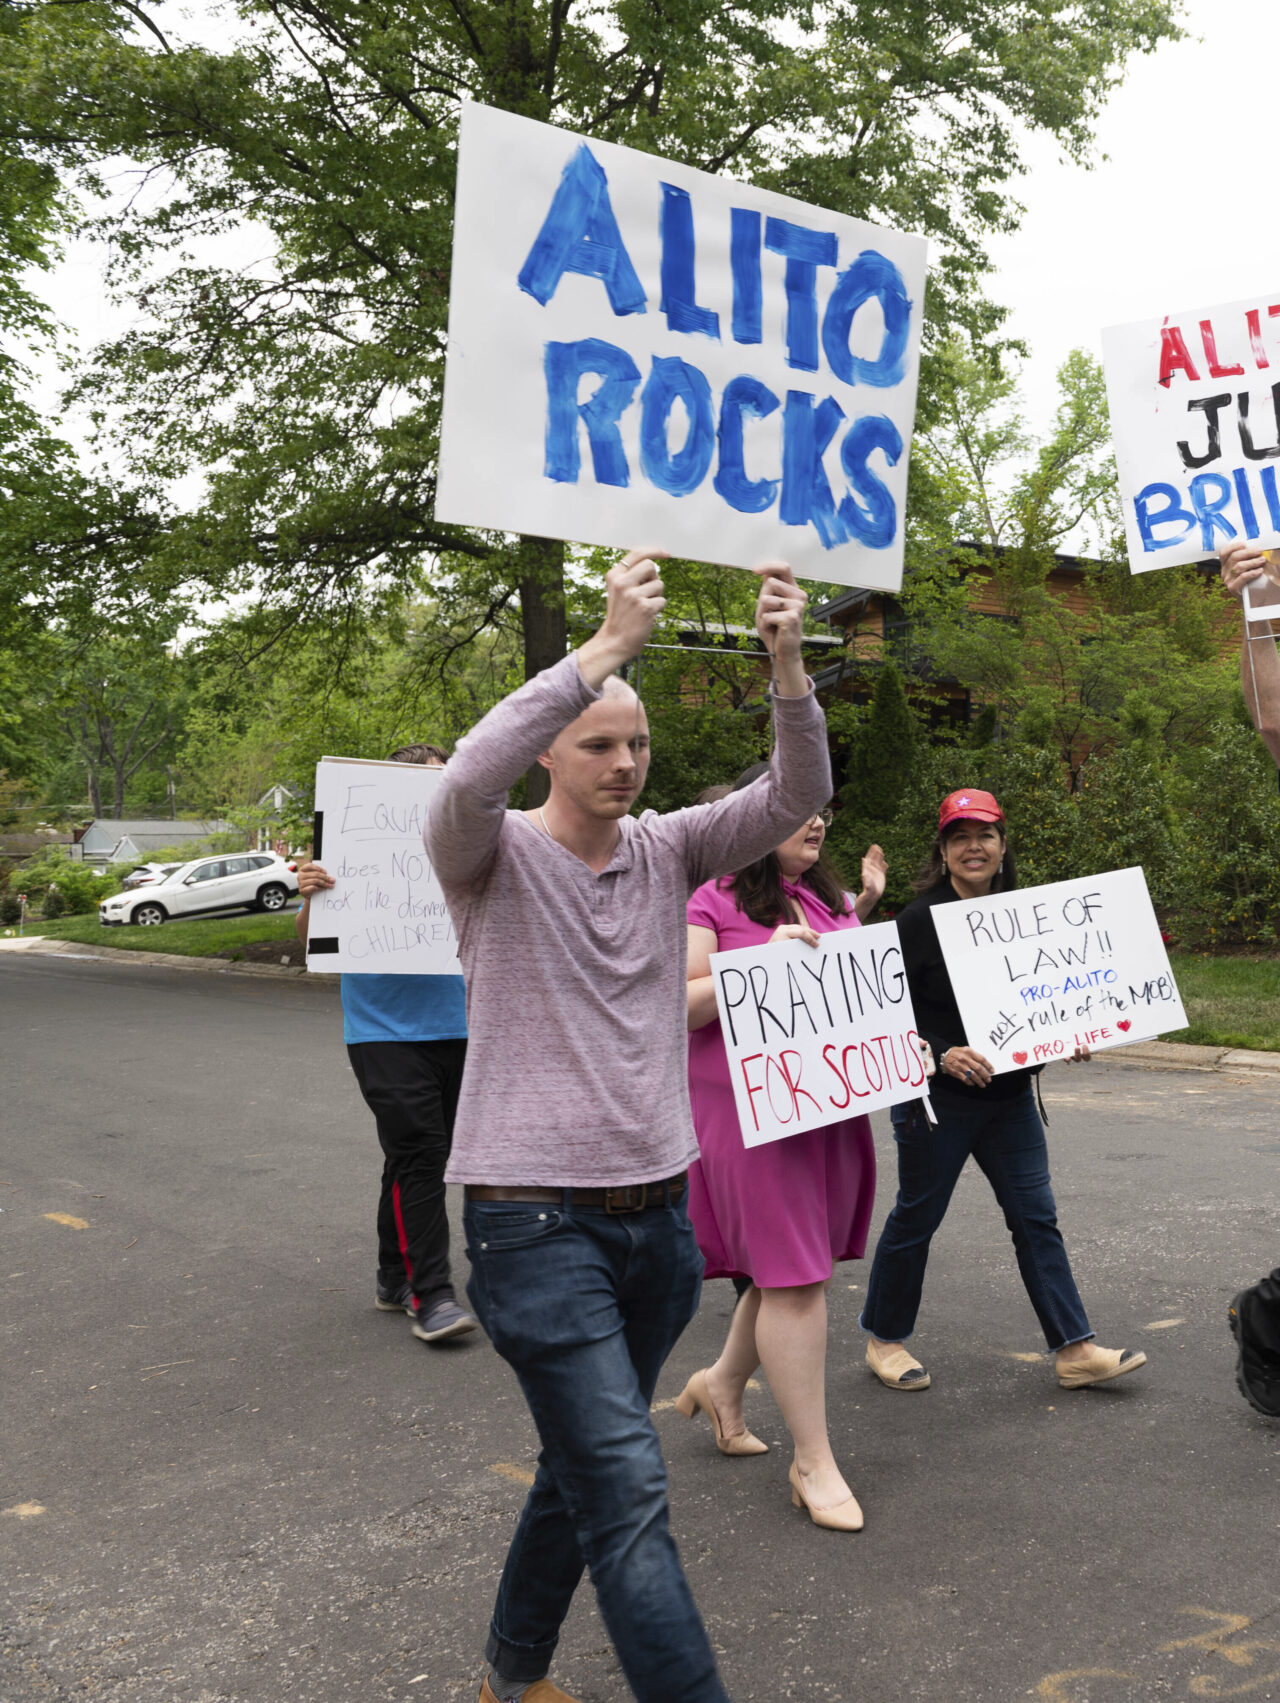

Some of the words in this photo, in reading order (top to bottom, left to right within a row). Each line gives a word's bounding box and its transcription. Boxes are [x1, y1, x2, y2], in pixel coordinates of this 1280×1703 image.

[517, 141, 912, 388] ALITO
[543, 337, 903, 550] ROCKS
[337, 855, 380, 878] does
[321, 890, 353, 911] look
[365, 881, 391, 911] like
[966, 902, 1053, 946] RULE
[1063, 893, 1102, 926] OF
[720, 947, 905, 1046] PRAYING
[1019, 969, 1118, 1006] PRO-ALITO
[989, 1011, 1017, 1046] not
[1028, 1001, 1070, 1031] rule
[1076, 995, 1093, 1021] of
[1099, 988, 1128, 1012] the
[1033, 1028, 1113, 1061] PRO-LIFE
[741, 1050, 823, 1132] FOR
[822, 1030, 925, 1109] SCOTUS
